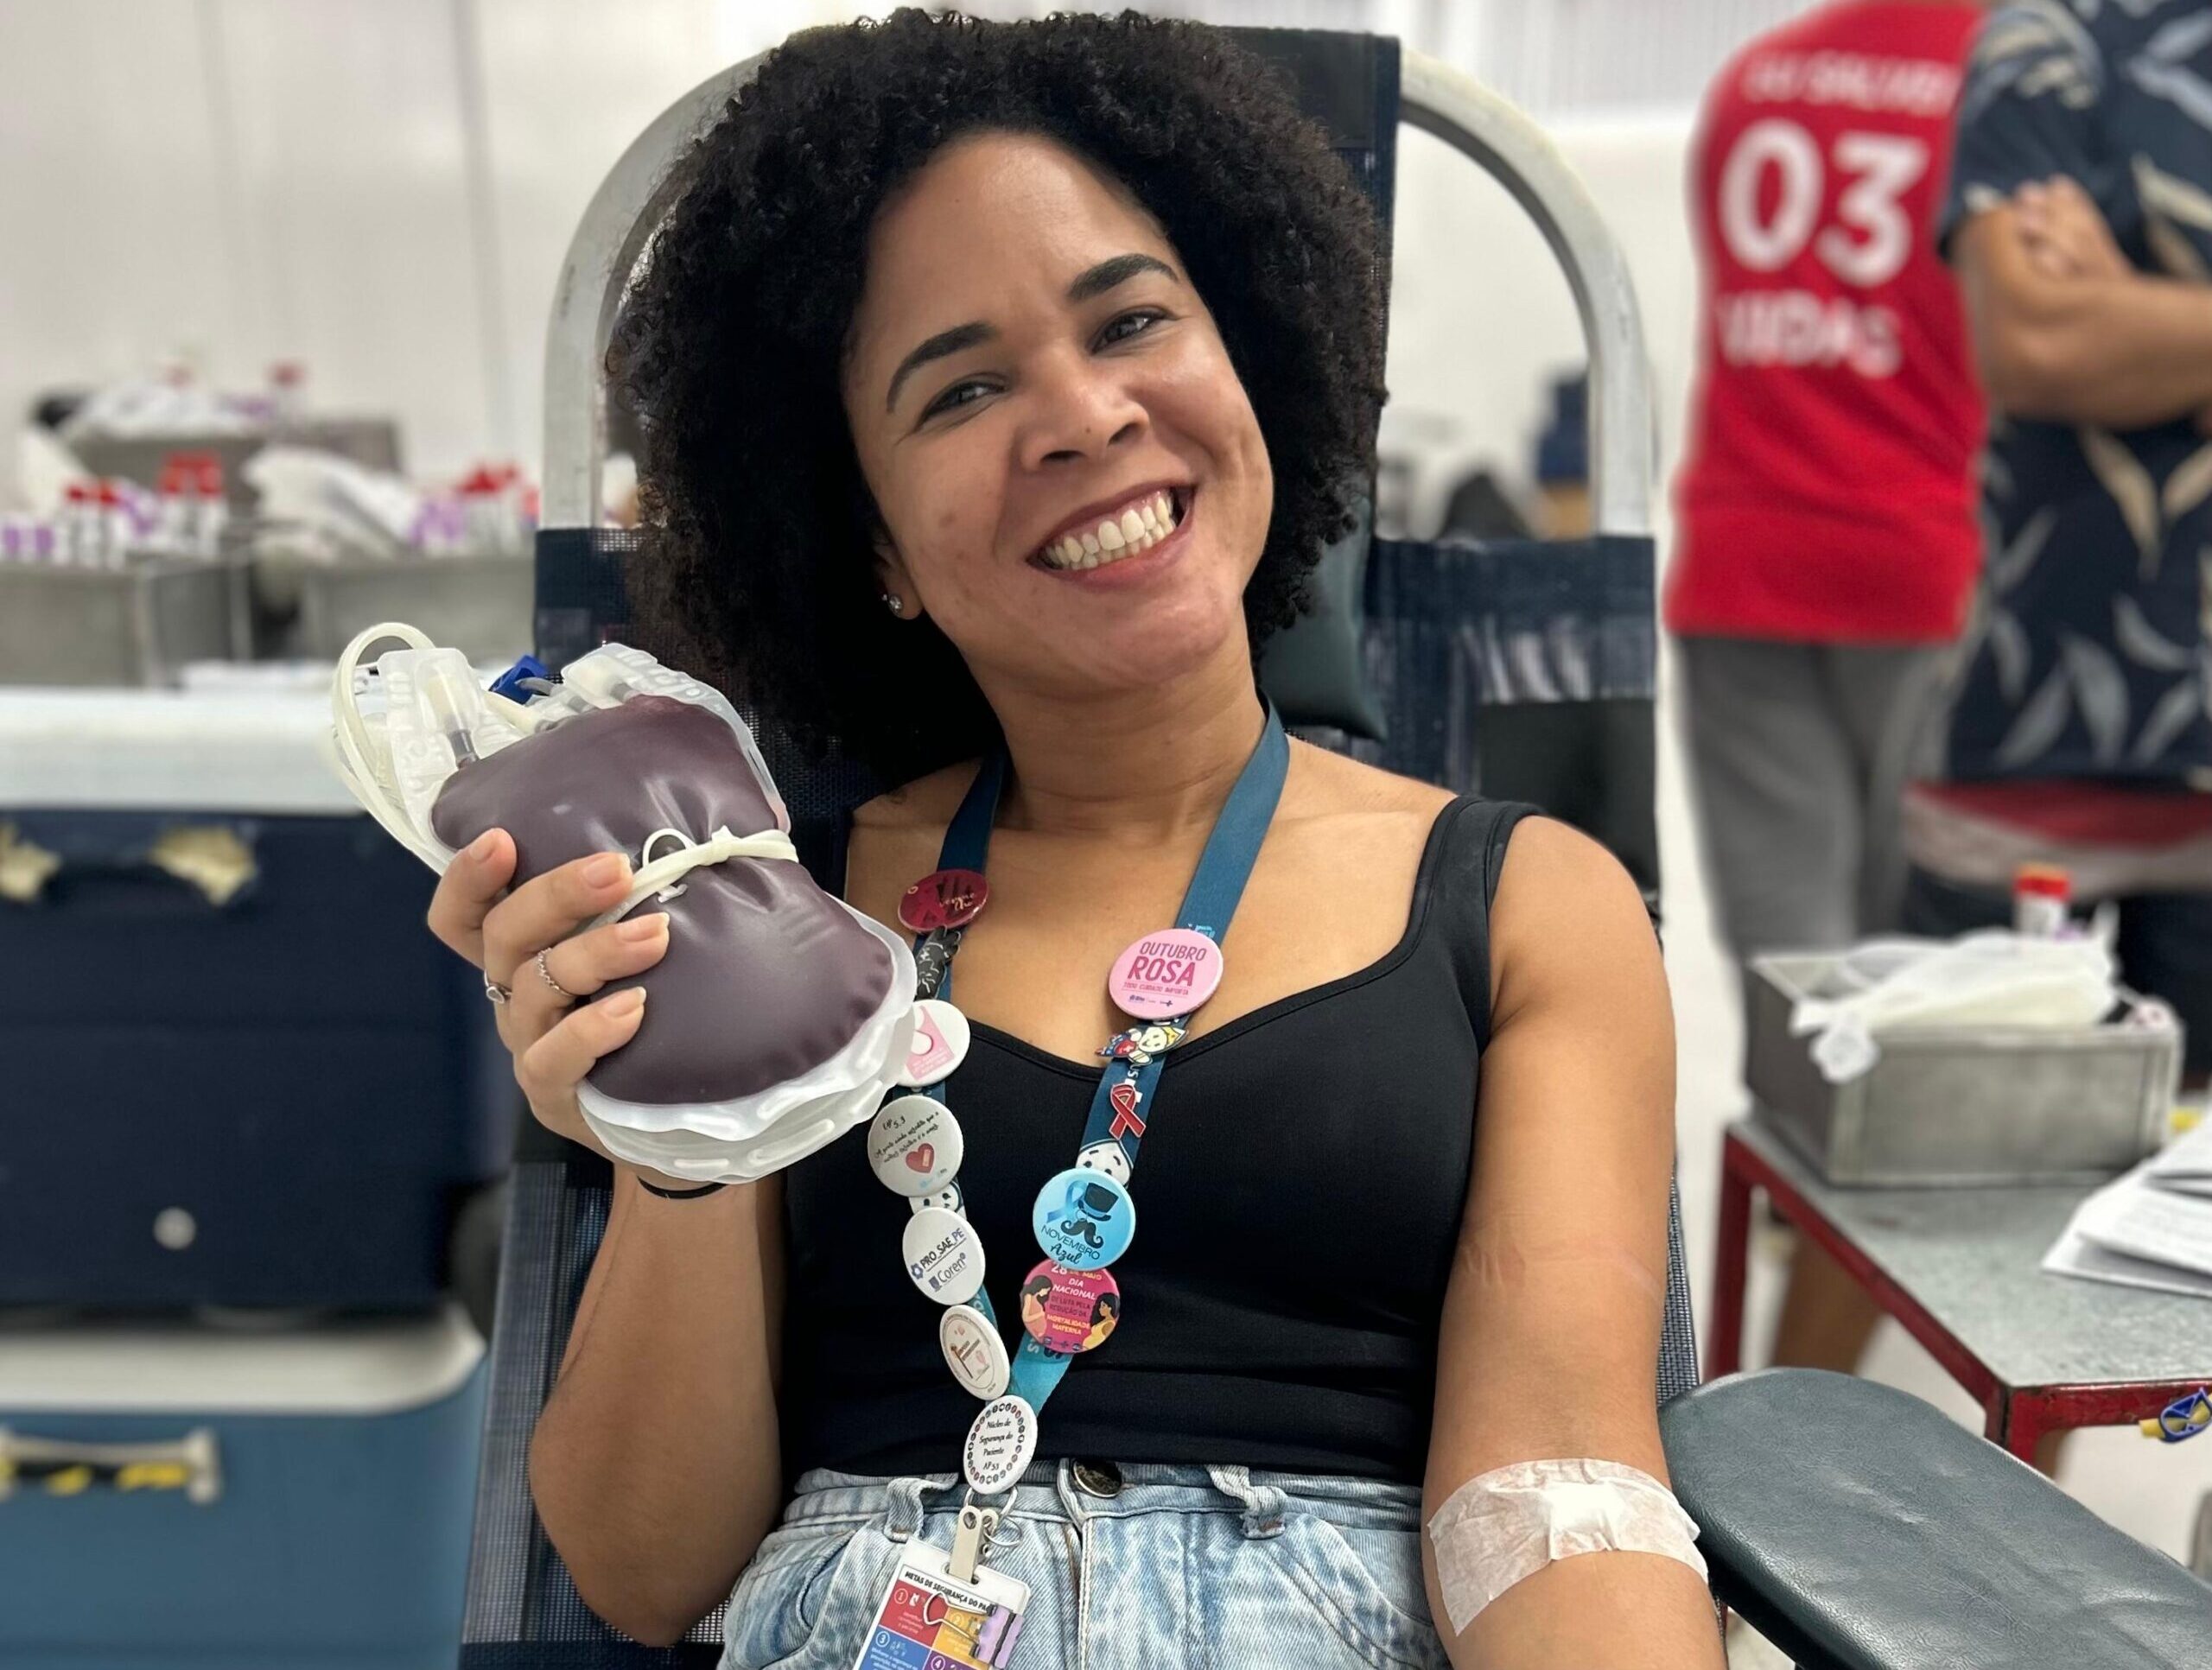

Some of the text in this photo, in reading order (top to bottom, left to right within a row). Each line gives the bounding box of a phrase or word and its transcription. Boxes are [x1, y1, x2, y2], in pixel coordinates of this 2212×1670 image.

[1718, 118, 1928, 288] 03
[1140, 942, 1207, 961] OUTUBRO
[1128, 956, 1196, 987] ROSA
[1041, 1225, 1100, 1260] NOVEMBRO
[1050, 1243, 1082, 1264] Azul
[1051, 1264, 1067, 1274] 28
[1052, 1284, 1096, 1300] NACIONAL
[1068, 1279, 1084, 1287] DIA
[1052, 1324, 1082, 1335] MATERNA
[905, 1572, 924, 1584] METAS
[925, 1579, 933, 1588] DE
[933, 1584, 967, 1603] SEGURANÇA
[968, 1597, 978, 1607] DO
